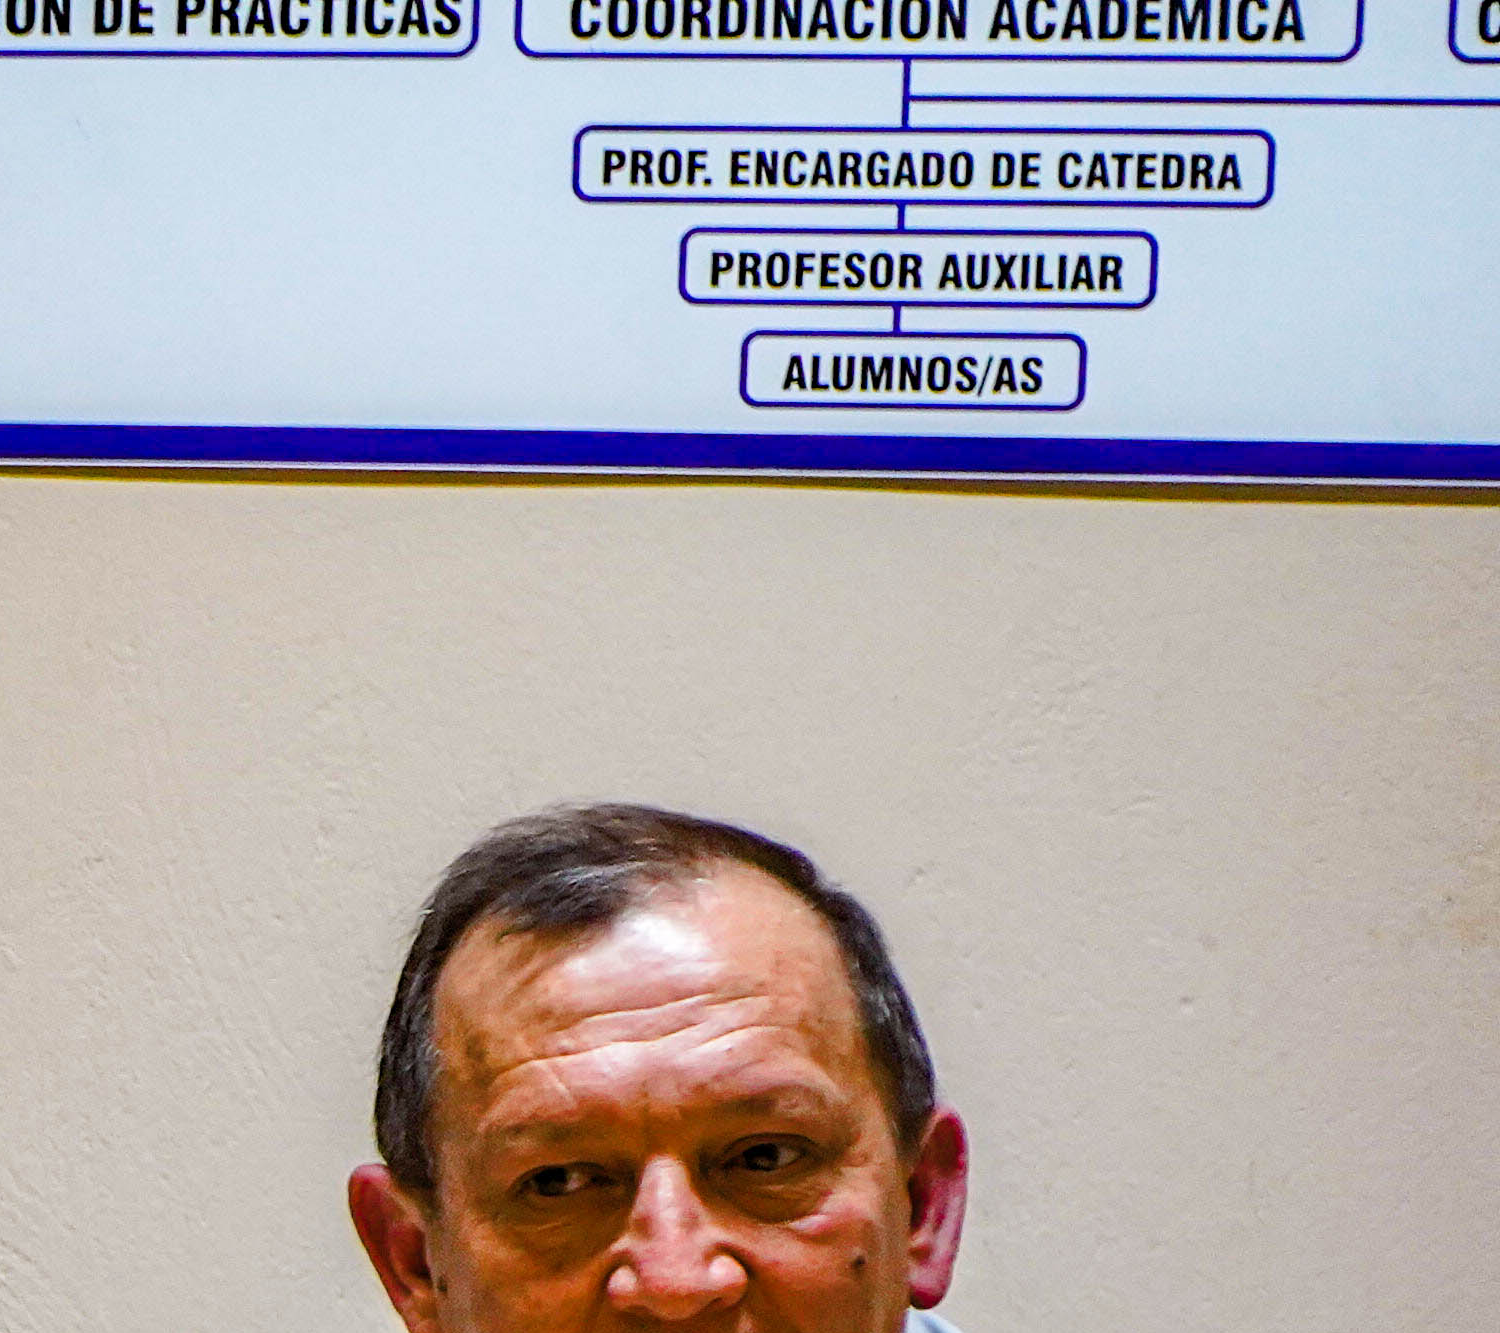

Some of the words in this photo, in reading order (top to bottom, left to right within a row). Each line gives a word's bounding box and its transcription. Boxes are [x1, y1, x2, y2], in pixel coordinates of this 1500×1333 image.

[94, 0, 154, 36] DE
[602, 150, 713, 188] PROF.
[730, 151, 974, 188] ENCARGADO
[992, 152, 1041, 189] DE
[1058, 154, 1243, 190] CATEDRA
[710, 252, 921, 290] PROFESOR
[940, 254, 1124, 292] AUXILIAR
[783, 355, 1044, 396] ALUMNOS/AS
